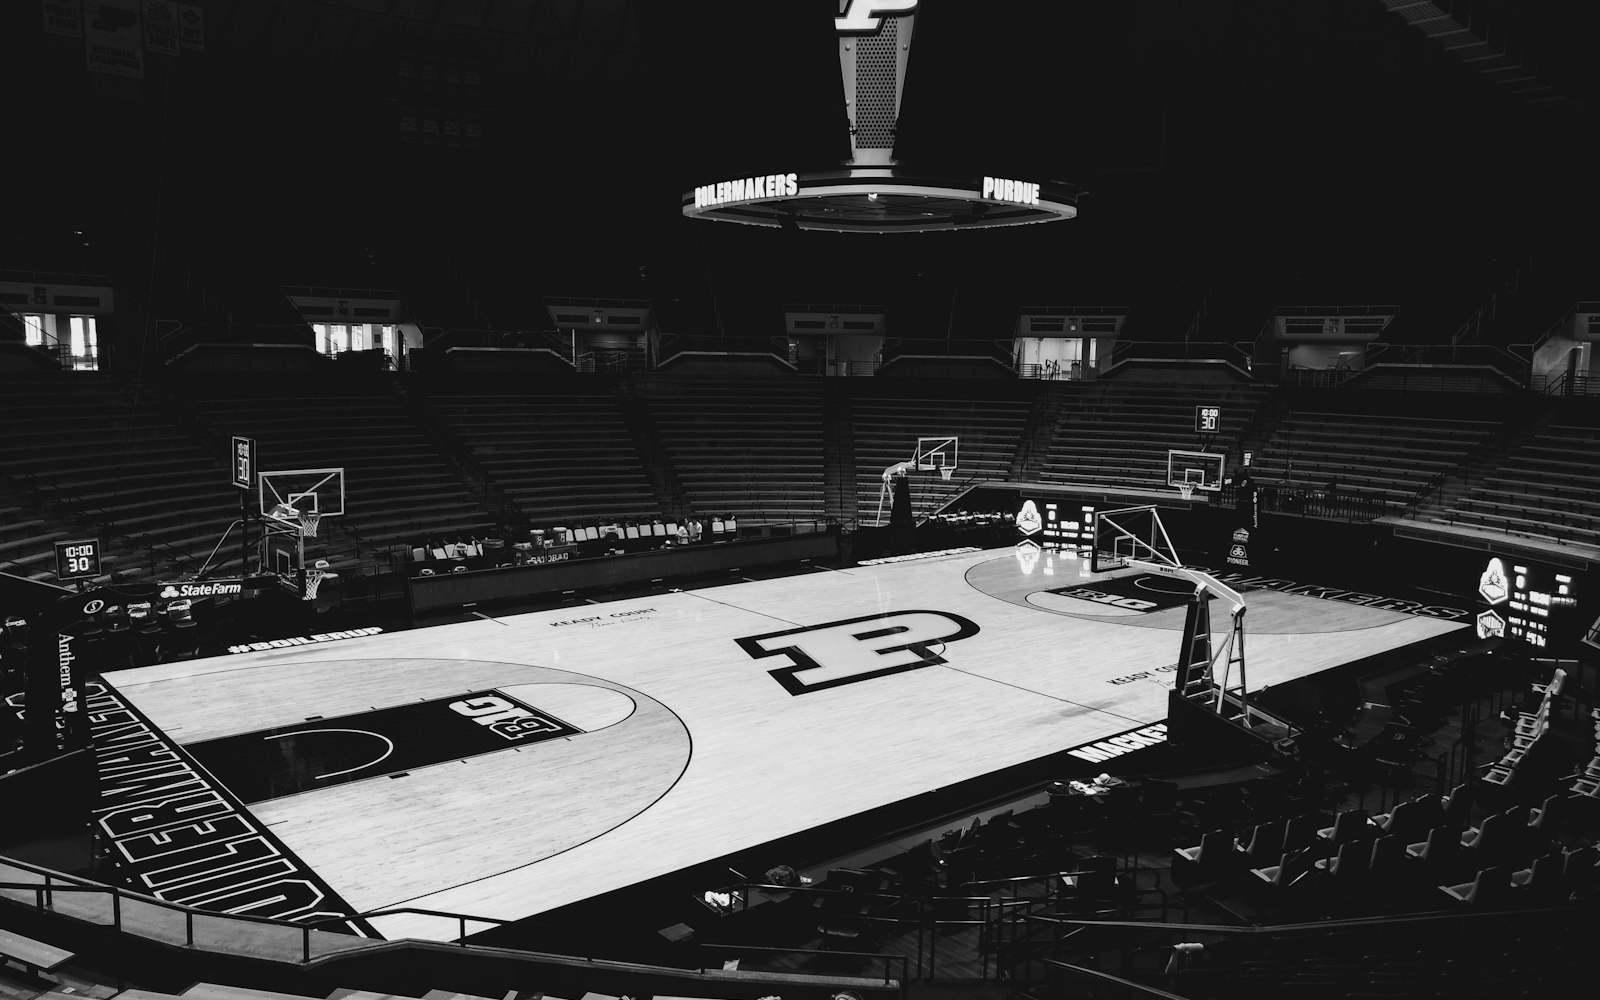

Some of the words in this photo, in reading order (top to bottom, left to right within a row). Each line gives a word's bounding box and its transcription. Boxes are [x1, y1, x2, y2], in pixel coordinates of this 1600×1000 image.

[694, 172, 798, 208] BOILERMAKERS
[982, 176, 1041, 206] PURDUE
[1201, 417, 1216, 431] 30
[65, 544, 94, 558] 10:00
[1226, 556, 1251, 567] PIONEER
[68, 557, 91, 573] 30
[549, 616, 603, 628] KEADY
[609, 607, 659, 618] COURT
[227, 626, 384, 654] #BOILERUP
[57, 632, 76, 690] Anthem
[736, 610, 981, 696] P
[1105, 671, 1156, 686] KEADY
